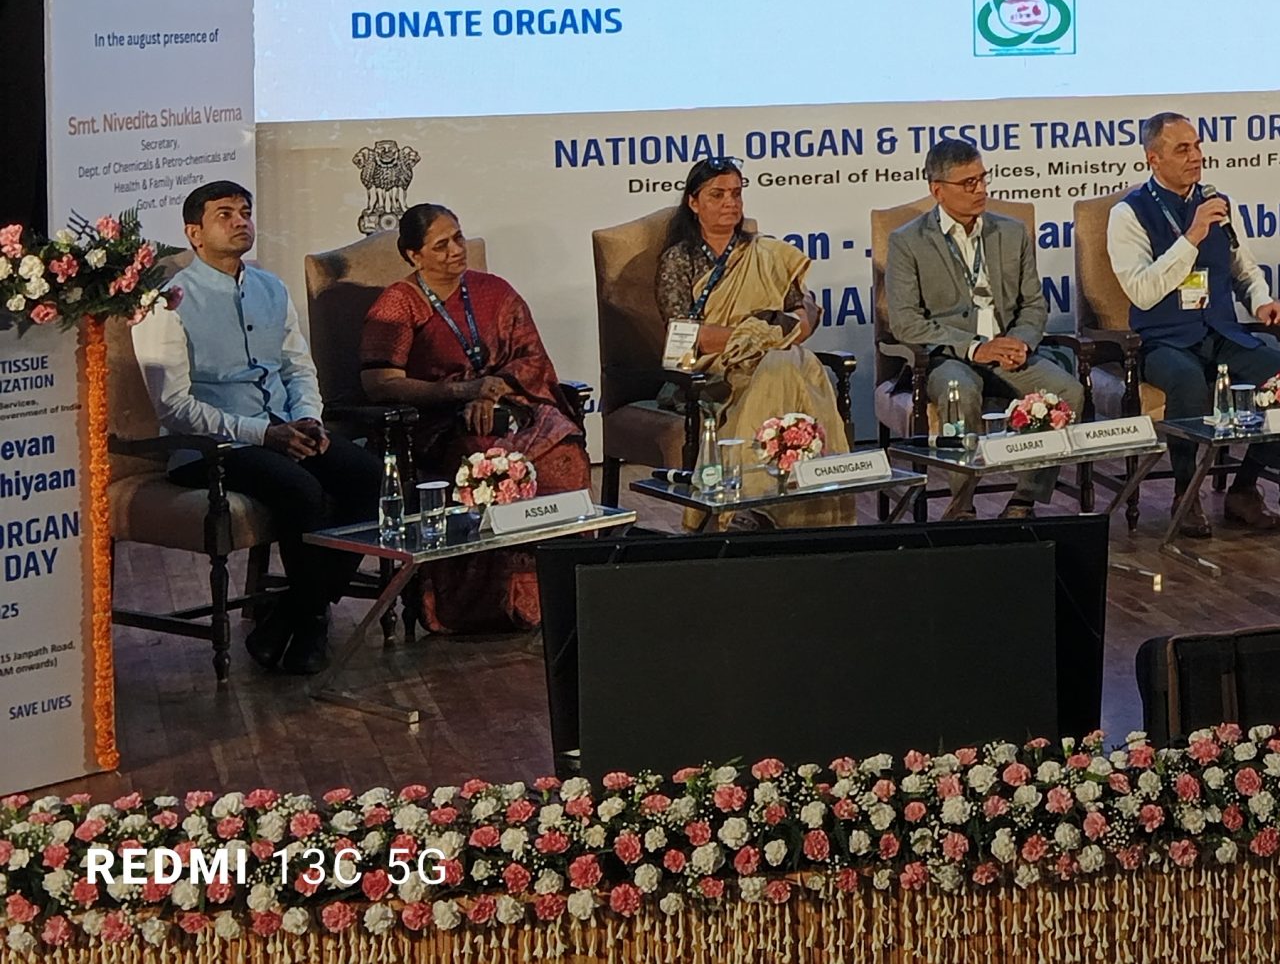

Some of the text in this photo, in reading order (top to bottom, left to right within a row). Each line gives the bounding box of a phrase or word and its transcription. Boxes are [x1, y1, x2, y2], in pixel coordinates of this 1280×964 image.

[352, 8, 622, 39] DONATE ORGANS
[746, 127, 898, 160] ORGAN &
[757, 170, 840, 187] General
[847, 169, 869, 185] of
[1048, 160, 1126, 176] Ministry
[1226, 154, 1260, 168] and
[1085, 425, 1138, 439] KARNATAKA
[1005, 439, 1043, 453] GUJARAT
[814, 461, 873, 477] CHANDIGARH
[525, 503, 559, 519] ASSAM
[5, 547, 58, 582] DAY
[9, 694, 72, 720] SAVE LIVES
